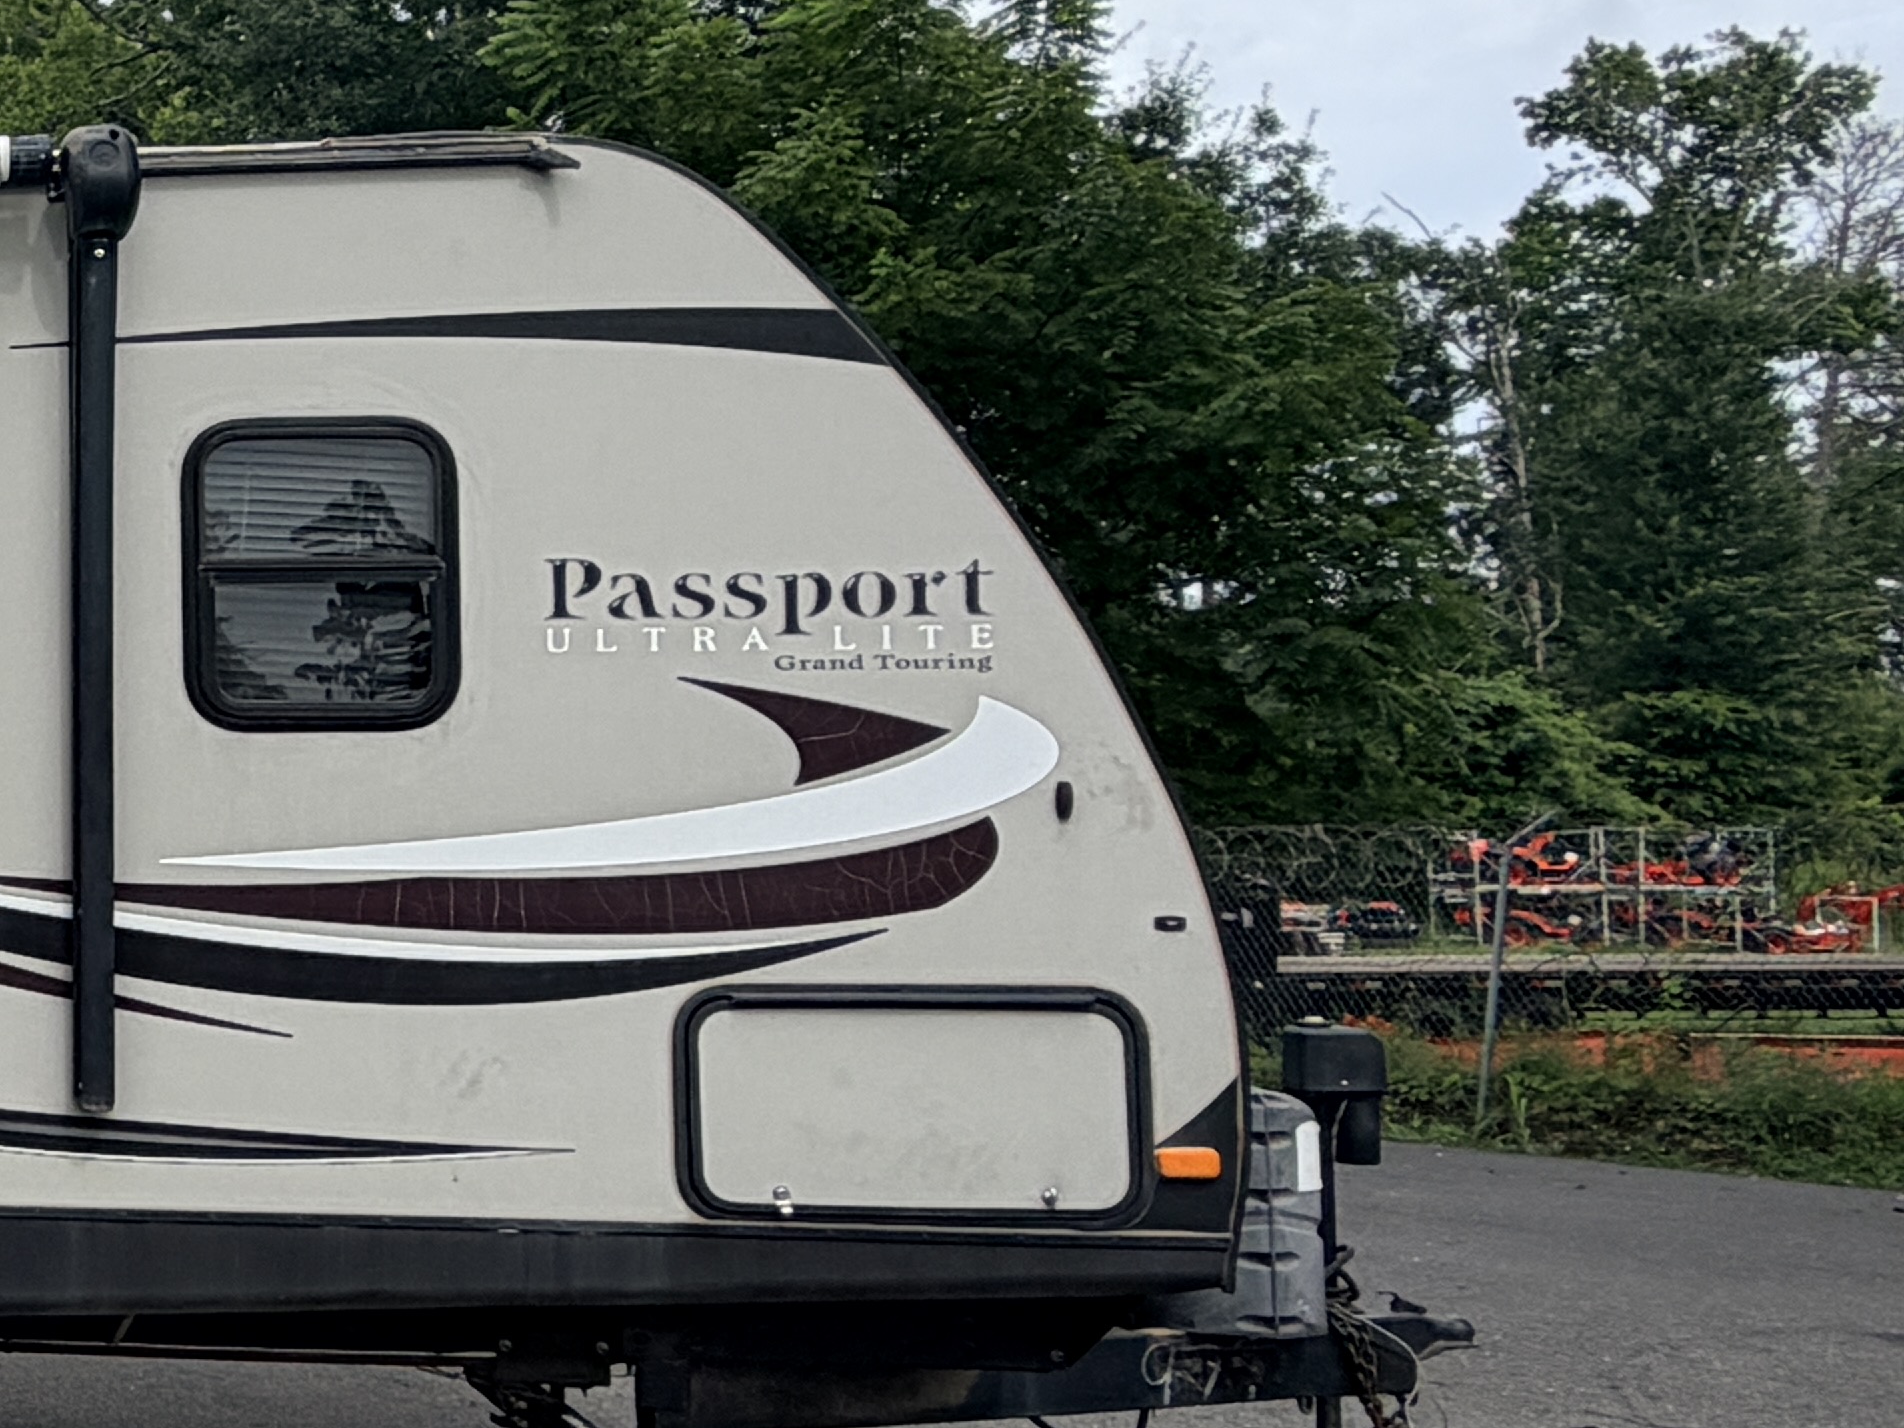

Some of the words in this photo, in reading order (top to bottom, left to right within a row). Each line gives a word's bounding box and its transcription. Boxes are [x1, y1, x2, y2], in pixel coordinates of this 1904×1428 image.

[543, 558, 994, 636] Passport
[547, 627, 769, 652] ULTRA
[833, 624, 994, 650] LITE
[774, 654, 864, 671] Grand
[874, 654, 993, 673] Touring
